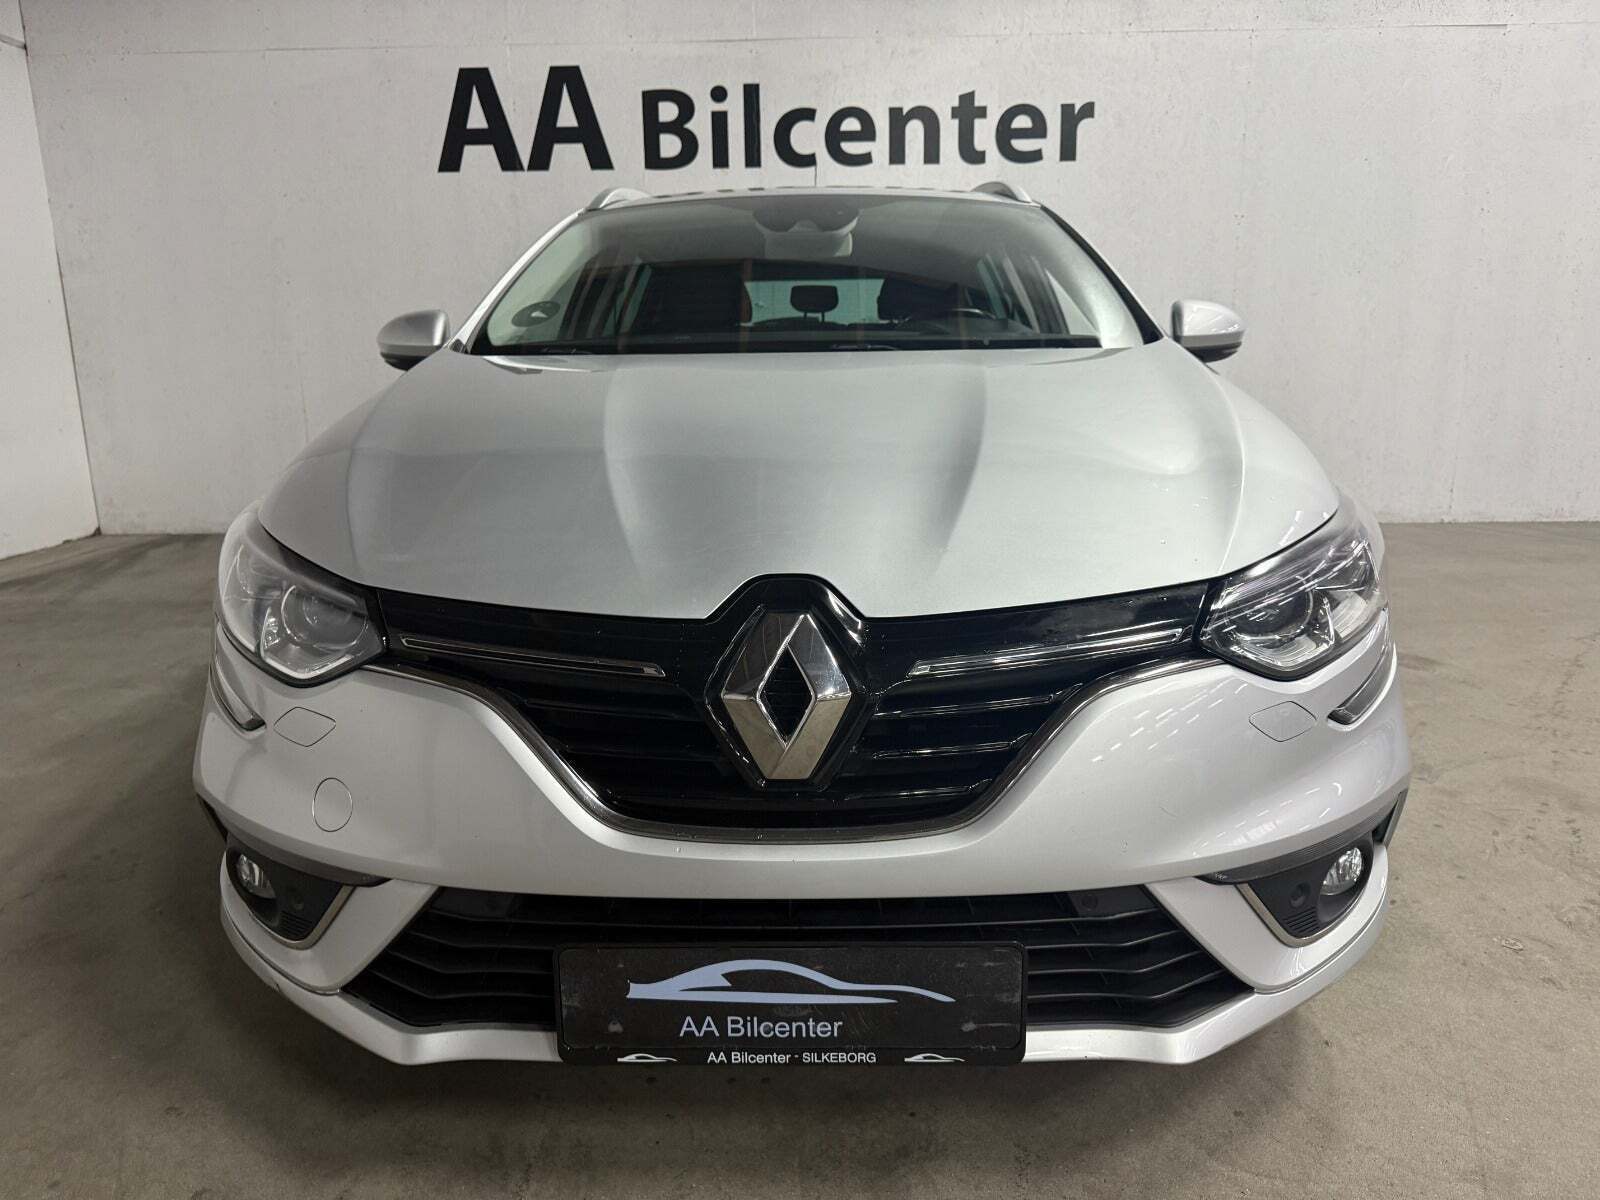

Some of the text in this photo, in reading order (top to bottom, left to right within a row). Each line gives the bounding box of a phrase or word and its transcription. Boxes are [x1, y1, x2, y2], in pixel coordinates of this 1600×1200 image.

[437, 65, 1095, 173] AA Bilcenter
[679, 1015, 843, 1038] AA Bilcenter
[707, 1051, 728, 1064] AA
[731, 1051, 792, 1064] Bilcenter
[802, 1051, 877, 1064] SILKEBORG
